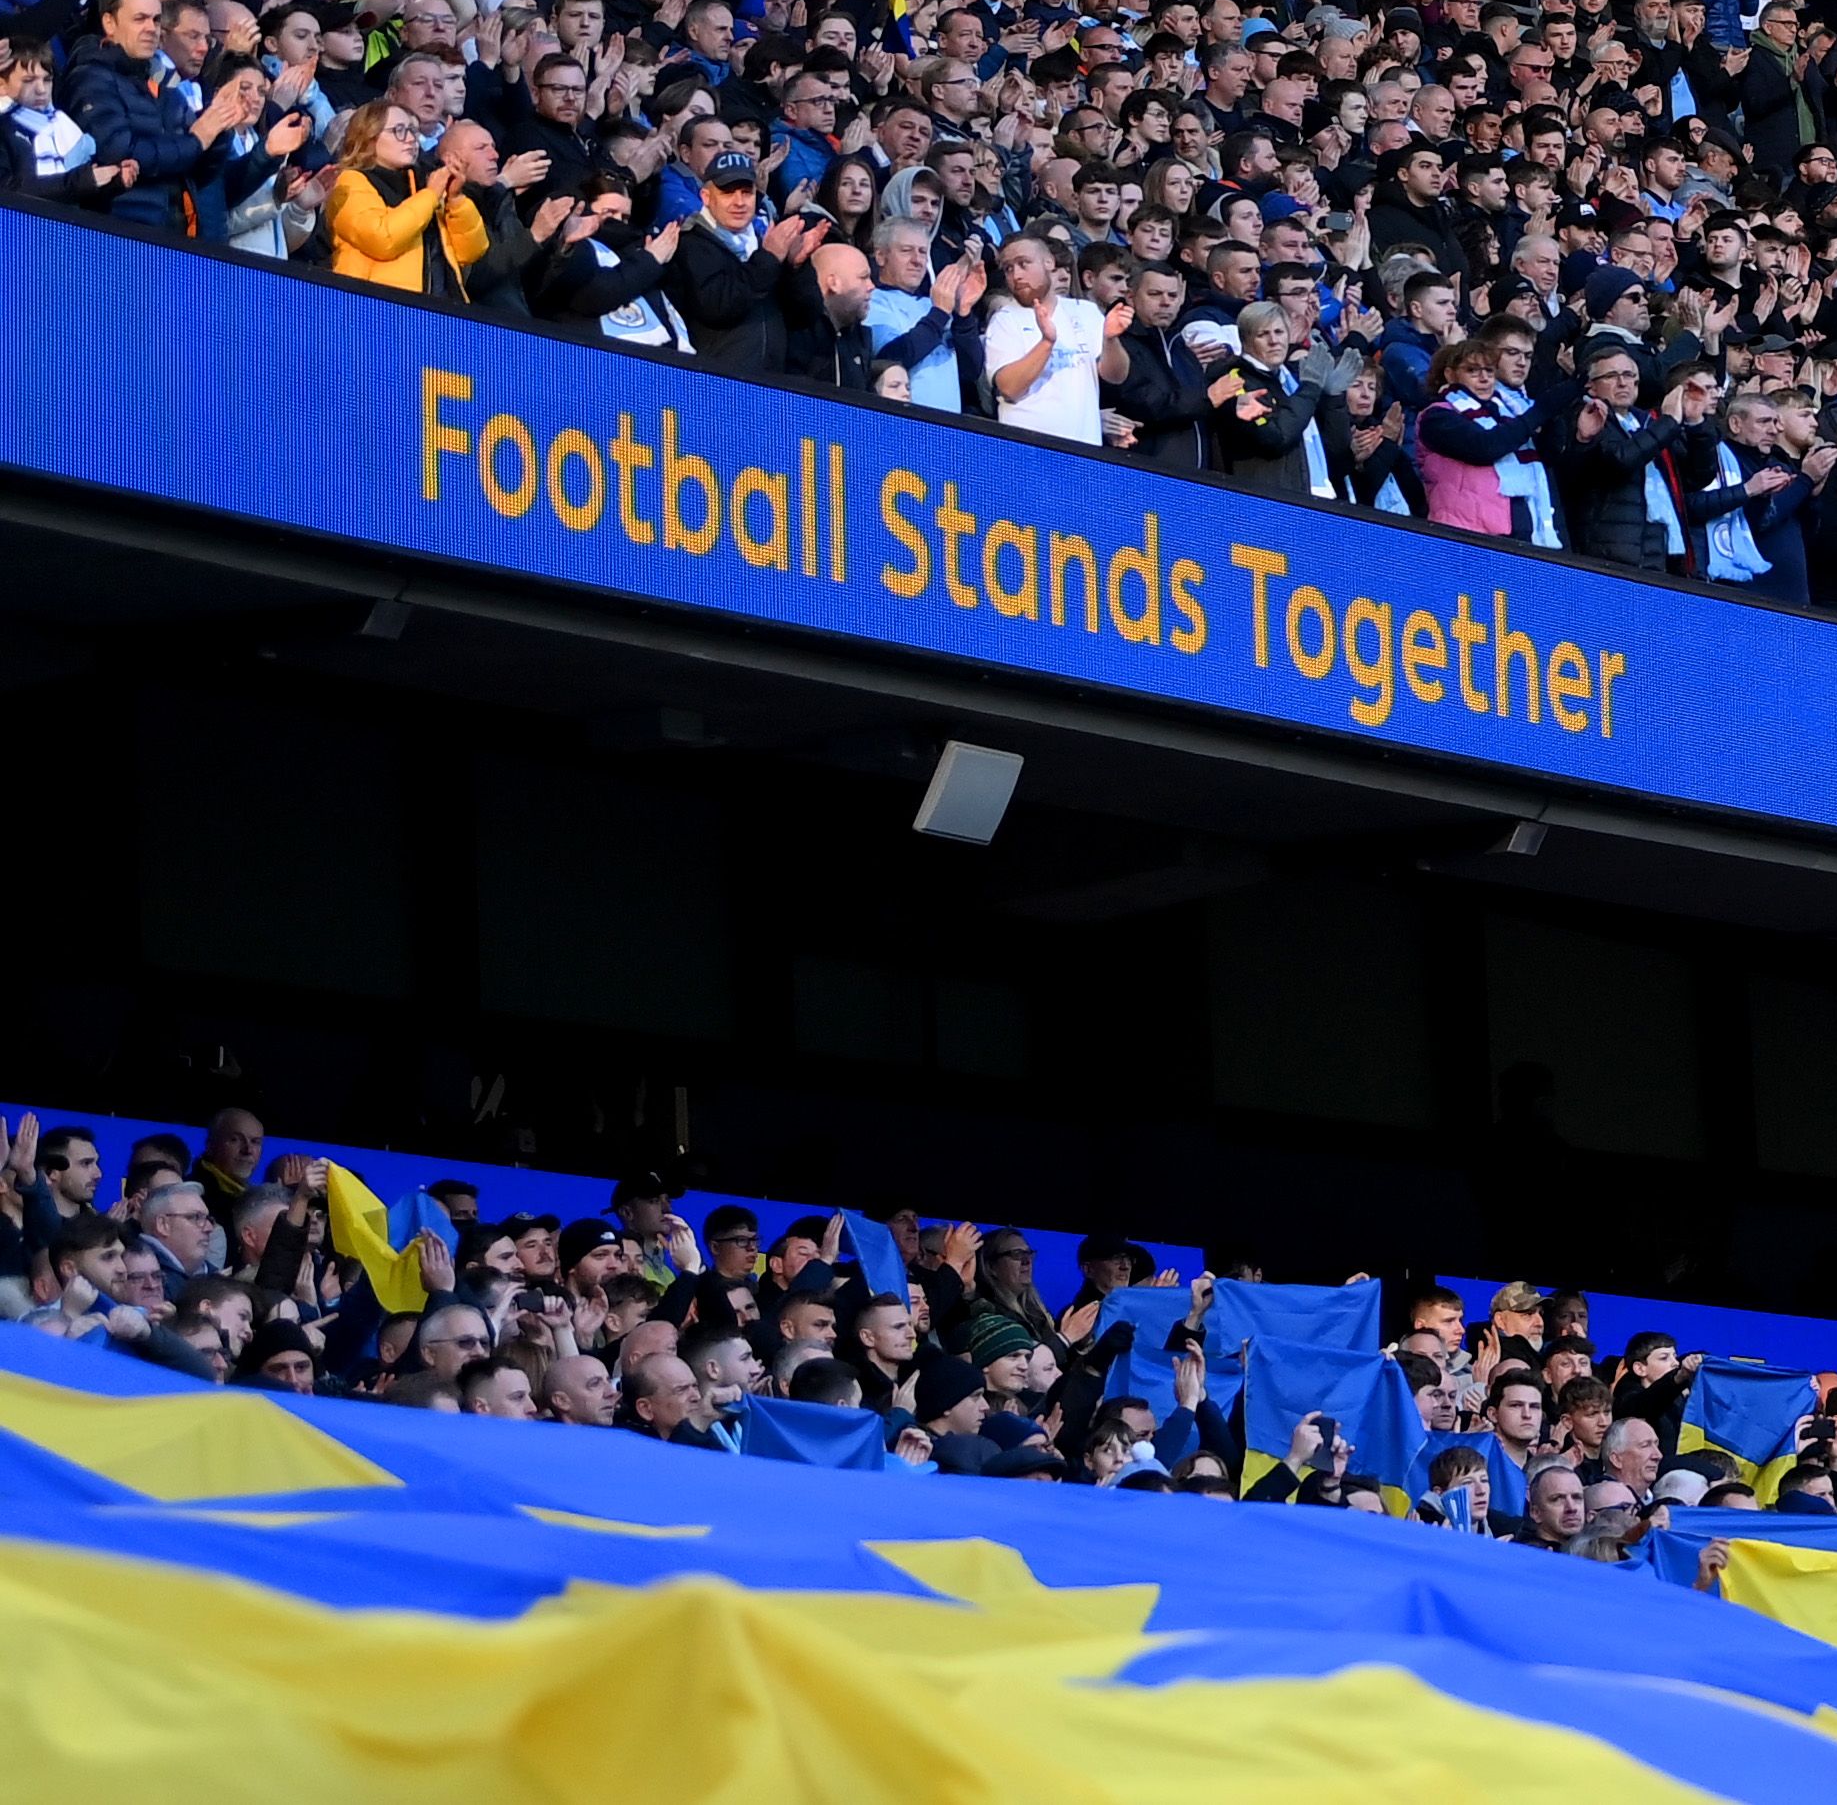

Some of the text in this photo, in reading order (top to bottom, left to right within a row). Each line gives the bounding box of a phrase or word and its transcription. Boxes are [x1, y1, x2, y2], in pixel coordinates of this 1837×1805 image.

[717, 154, 750, 168] CITY
[424, 368, 1626, 738] Football Stands Together
